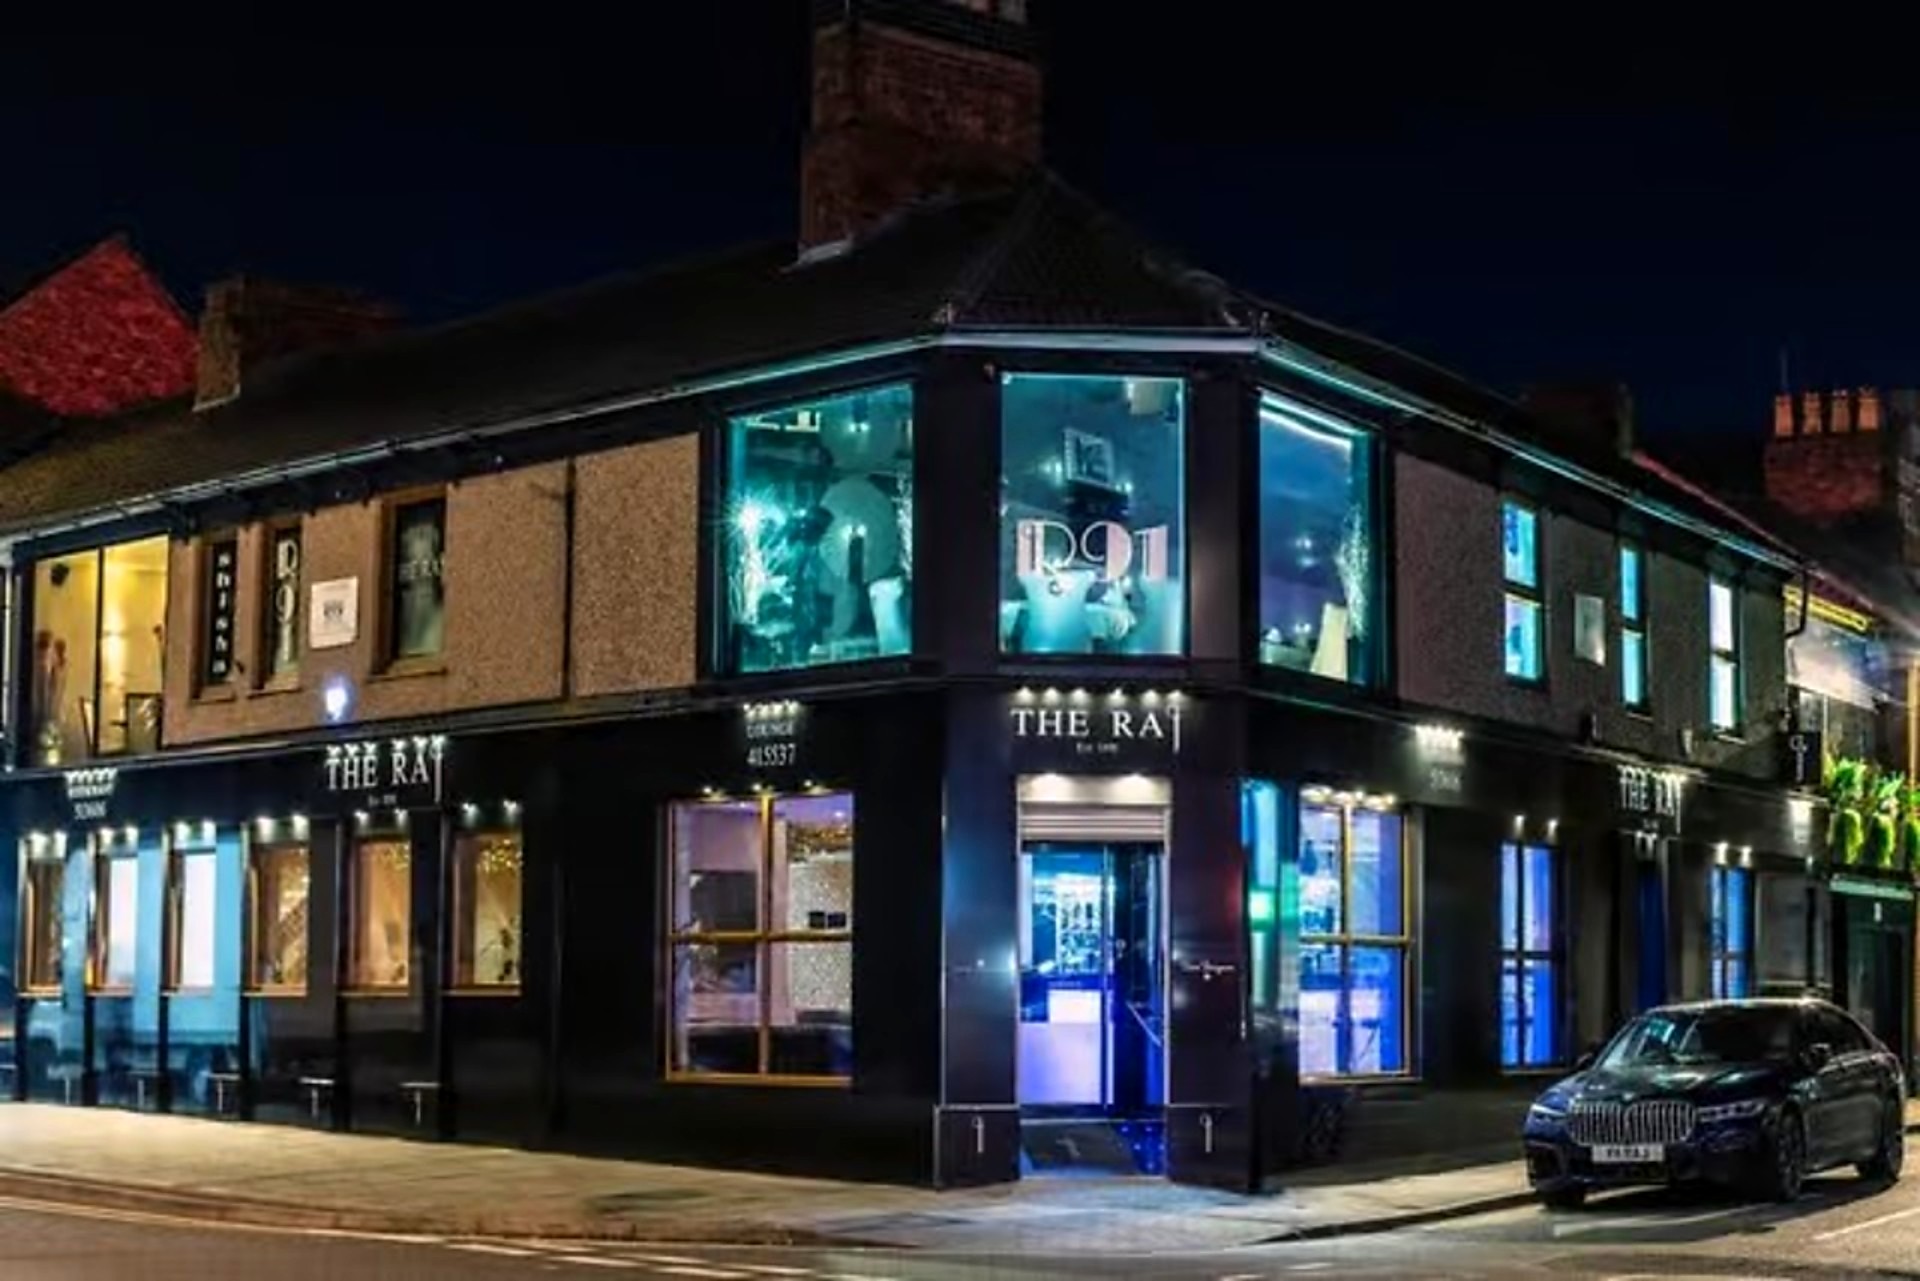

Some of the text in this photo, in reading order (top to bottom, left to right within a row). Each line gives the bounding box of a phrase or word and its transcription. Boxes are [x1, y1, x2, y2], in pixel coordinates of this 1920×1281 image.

[1016, 520, 1168, 582] R91
[1010, 708, 1089, 736] THE
[324, 755, 378, 790] THE
